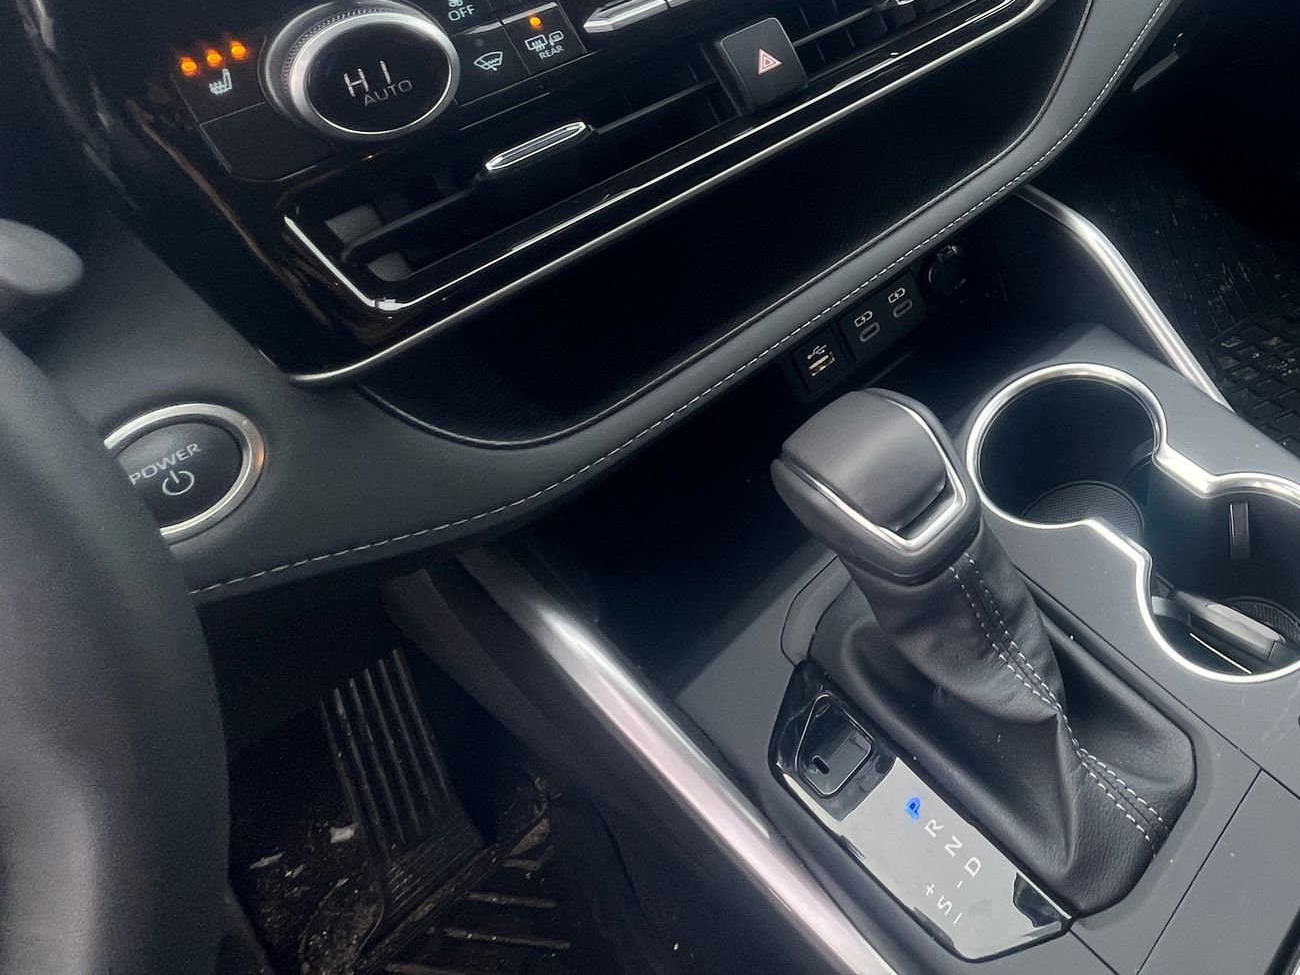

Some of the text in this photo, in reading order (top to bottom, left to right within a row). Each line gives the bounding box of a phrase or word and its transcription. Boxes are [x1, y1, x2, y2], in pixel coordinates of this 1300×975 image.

[448, 4, 476, 21] OFF
[538, 45, 565, 61] REAR
[363, 79, 413, 108] AUTO
[129, 442, 202, 486] POWER
[904, 796, 921, 820] P
[924, 818, 945, 839] R
[943, 835, 964, 857] N
[963, 856, 982, 878] D
[937, 895, 952, 916] S
